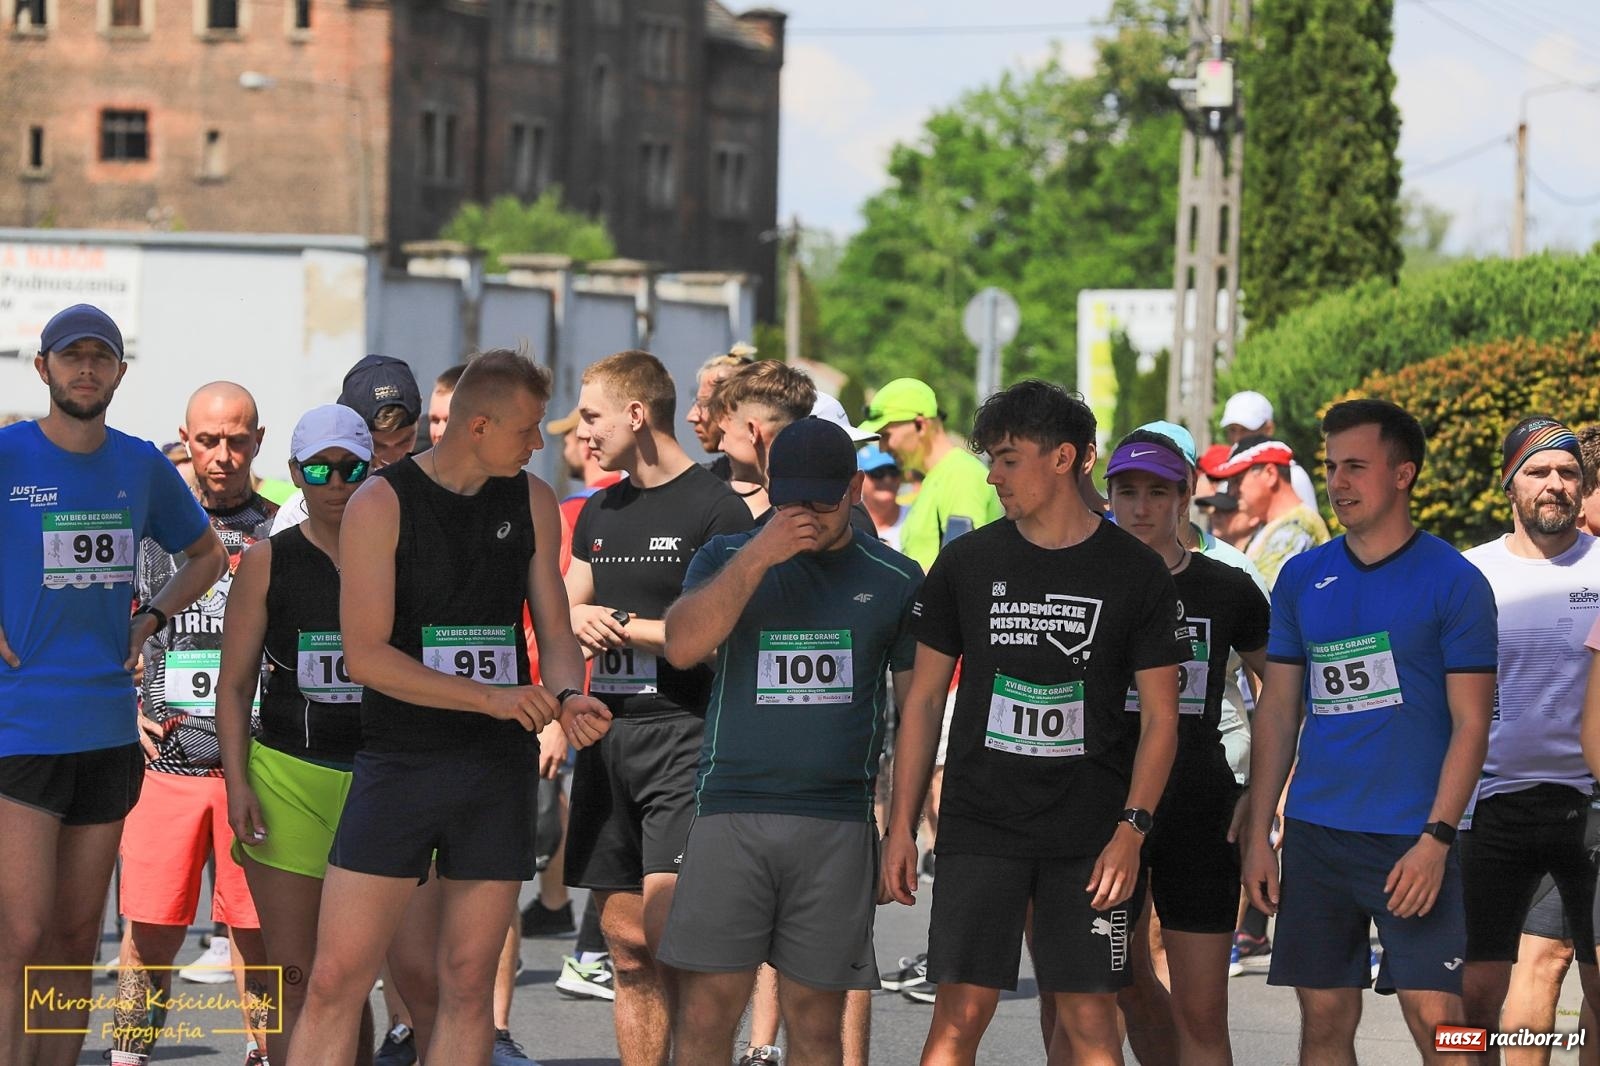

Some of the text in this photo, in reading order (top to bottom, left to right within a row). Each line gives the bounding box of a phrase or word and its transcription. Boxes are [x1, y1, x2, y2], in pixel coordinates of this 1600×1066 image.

[10, 486, 37, 495] JUST
[29, 493, 57, 502] TEAM
[73, 534, 114, 563] 98
[649, 537, 680, 550] DZIK
[990, 602, 1086, 618] AKADEMICKIE
[990, 617, 1086, 634] MISTRZOSTWA
[990, 633, 1038, 645] POLSKI
[1330, 644, 1345, 652] BEZ
[1345, 636, 1376, 649] GRANIC
[454, 650, 497, 679] 95
[776, 654, 837, 684] 100
[192, 672, 217, 698] 9
[1323, 661, 1370, 695] 85
[1005, 680, 1017, 690] XVI
[1017, 684, 1033, 693] BIEG
[1048, 686, 1074, 695] GRANIC
[1012, 704, 1064, 737] 110
